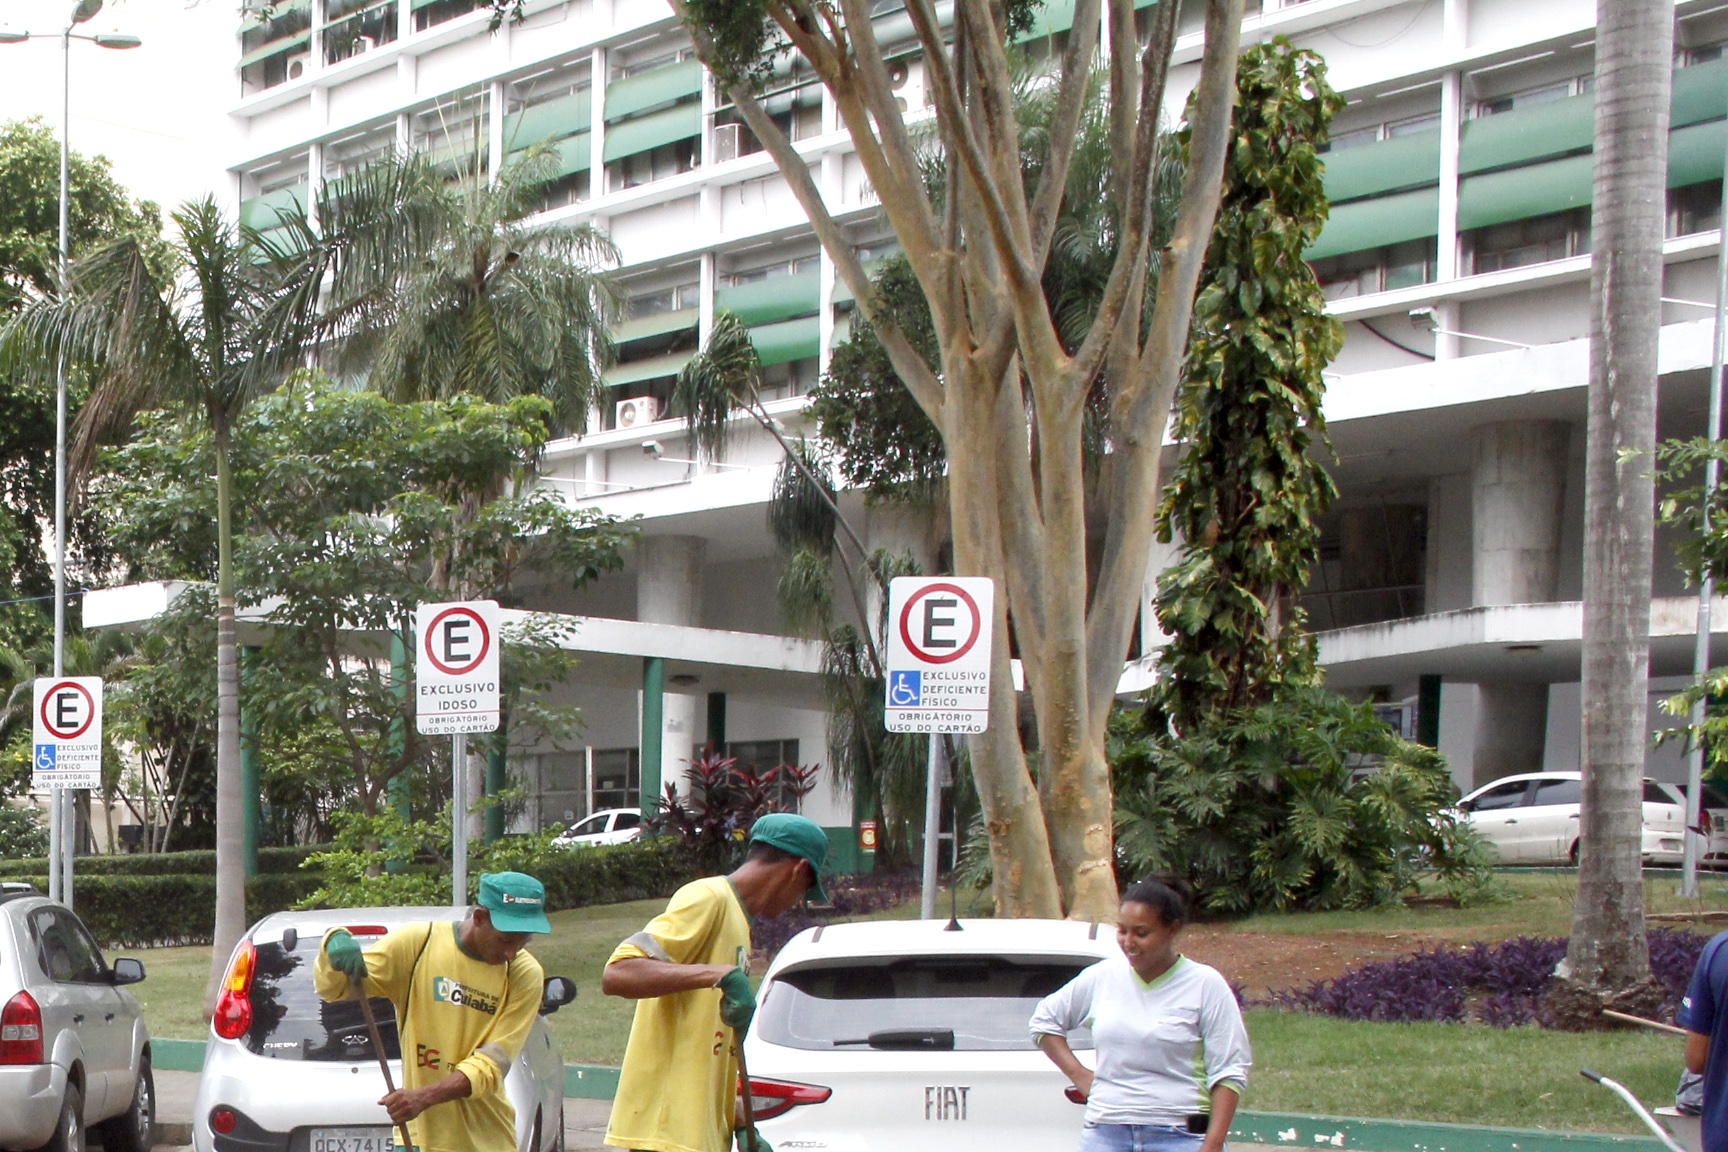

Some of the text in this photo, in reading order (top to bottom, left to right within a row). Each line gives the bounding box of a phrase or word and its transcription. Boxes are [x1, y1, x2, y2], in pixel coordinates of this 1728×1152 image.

[923, 599, 957, 648] E
[444, 620, 471, 662] E
[923, 671, 986, 681] EXCLUSIVO
[421, 682, 495, 695] EXCLUSIVO
[922, 685, 987, 695] DEFICIENTE
[438, 700, 477, 710] IDOSO
[922, 697, 958, 707] FÍSICO
[56, 692, 79, 728] E
[421, 723, 495, 734] USO DO CARTÃO
[889, 723, 981, 733] USO DO CARTÃO
[57, 744, 99, 752] EXCLUSIVO
[450, 989, 498, 1016] Cuiabá
[924, 1086, 971, 1120] FIAT
